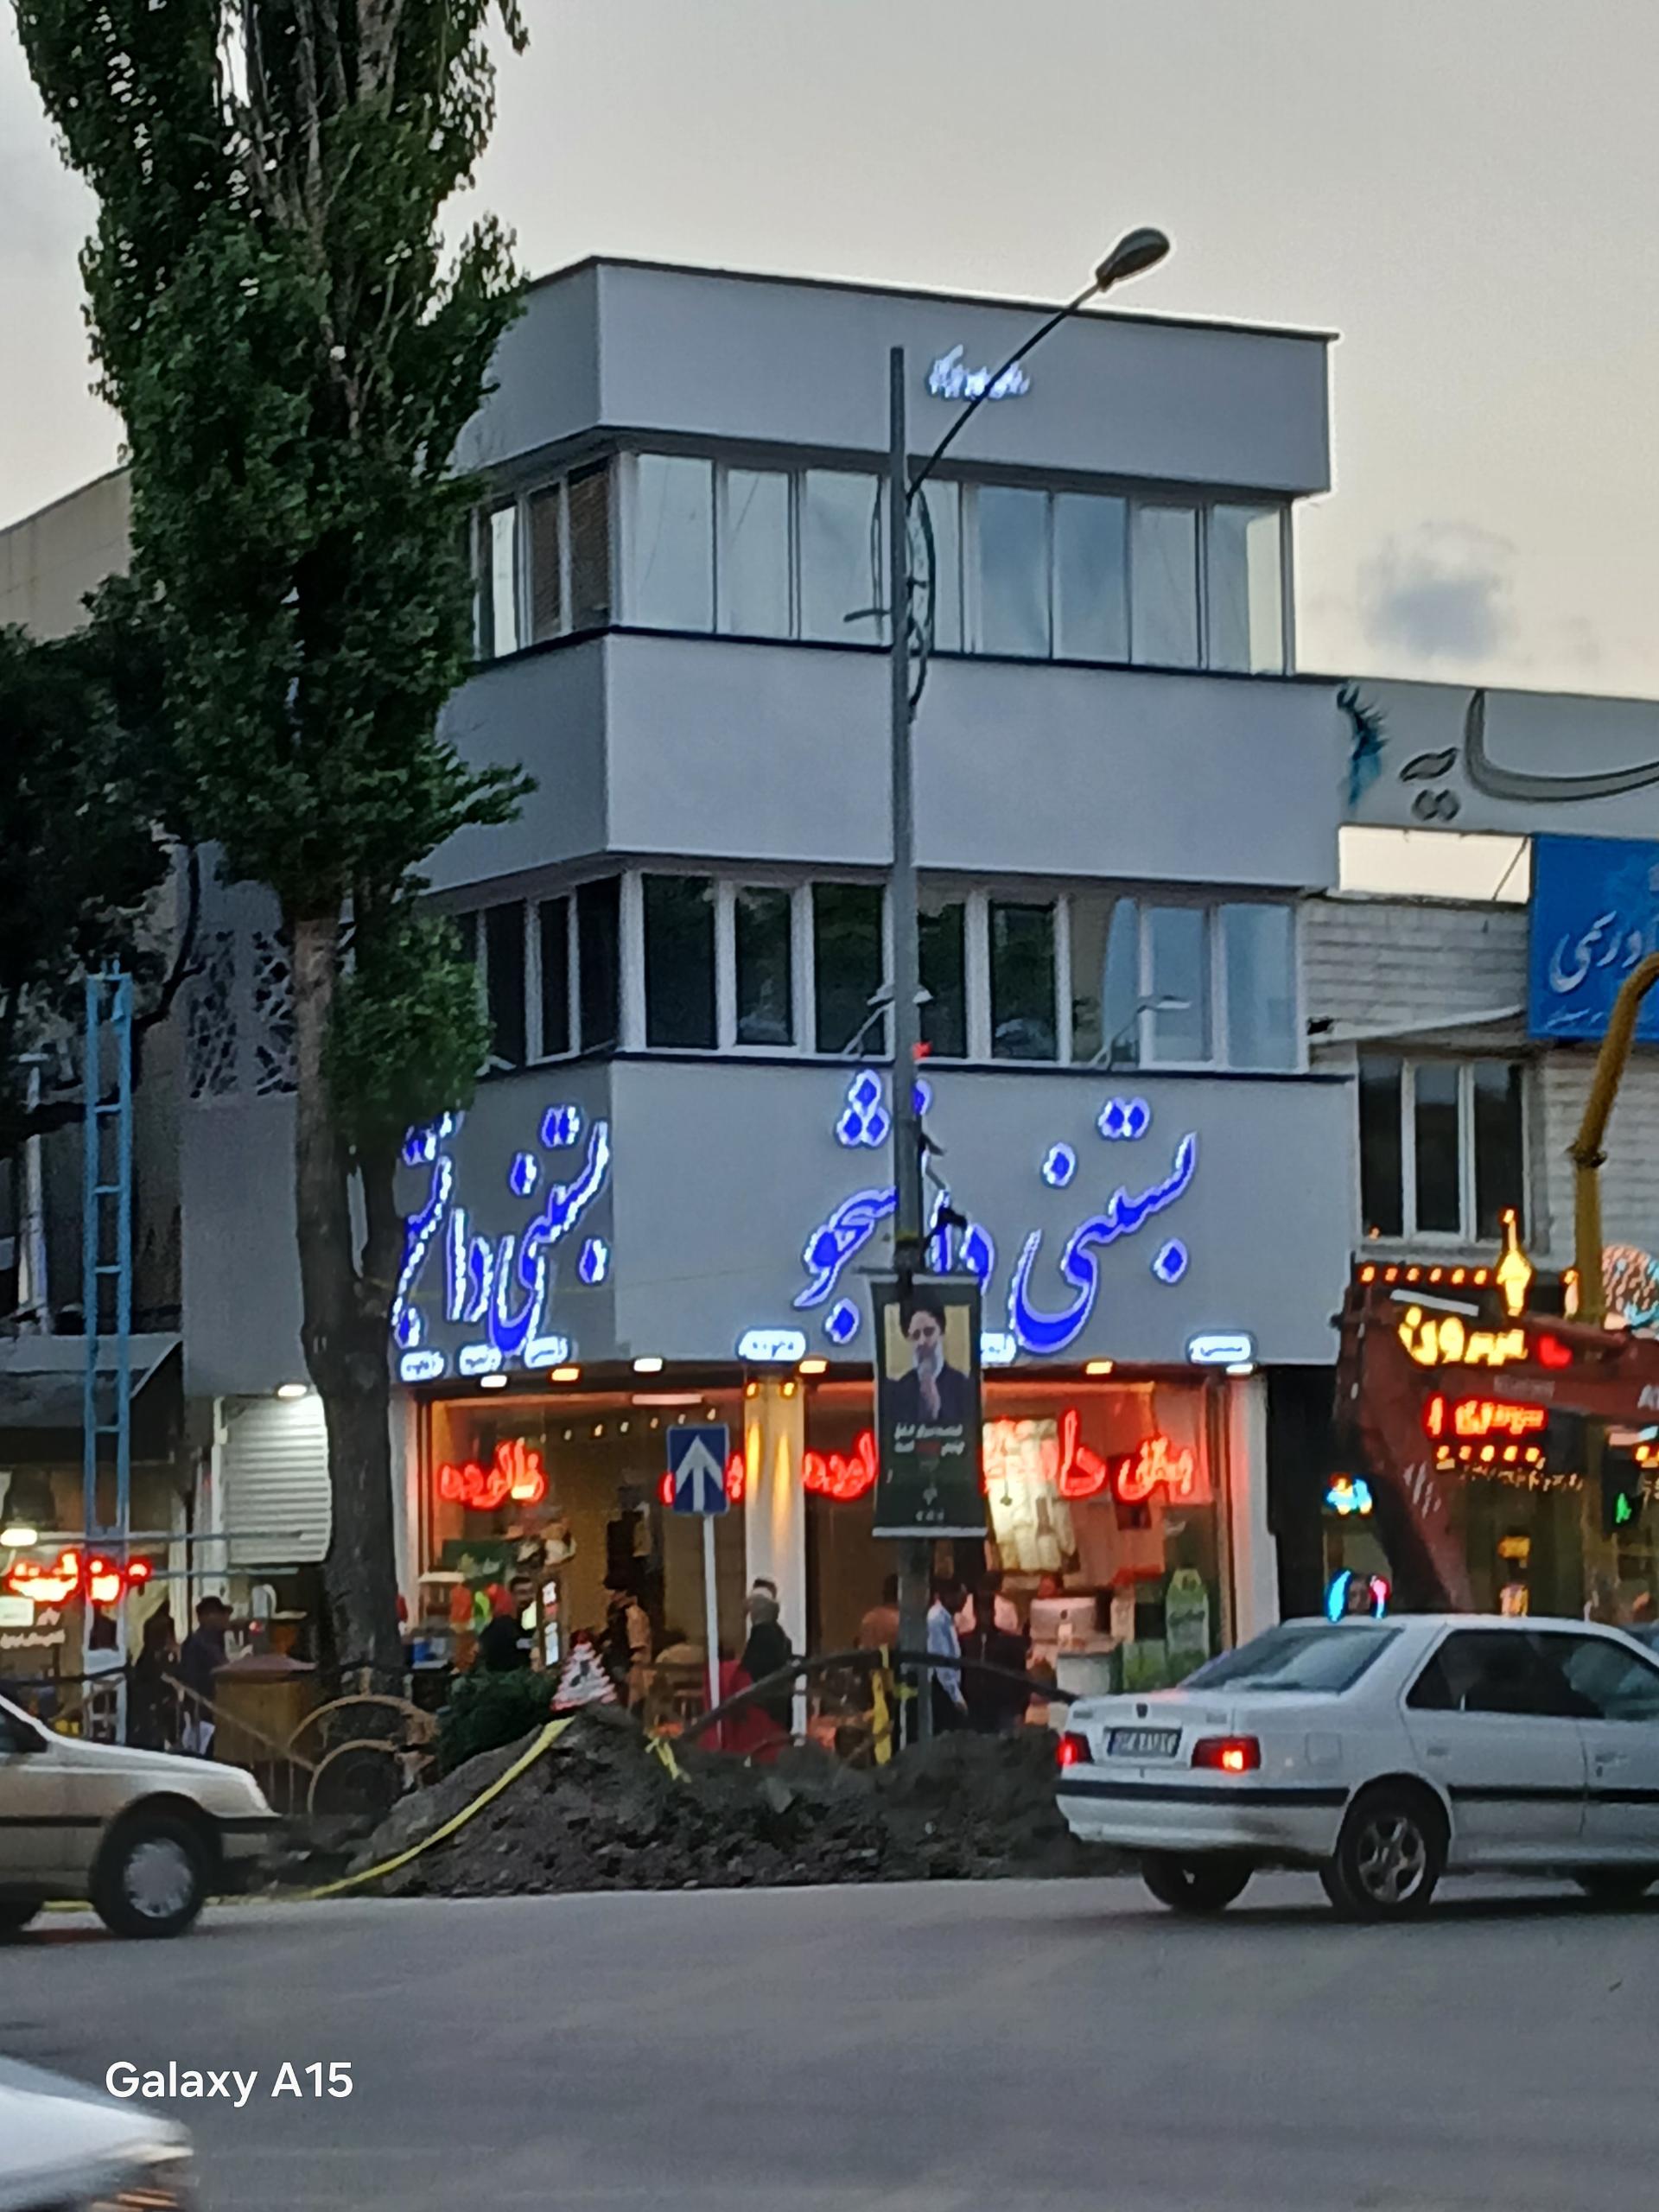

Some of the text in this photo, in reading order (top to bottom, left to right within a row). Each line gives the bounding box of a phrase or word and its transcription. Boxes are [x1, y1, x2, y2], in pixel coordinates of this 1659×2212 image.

[487, 1101, 609, 1356] بستنی
[783, 1067, 1198, 1353] بستنی داشجو
[441, 1438, 545, 1508] فالوده
[803, 1428, 877, 1500] لوده
